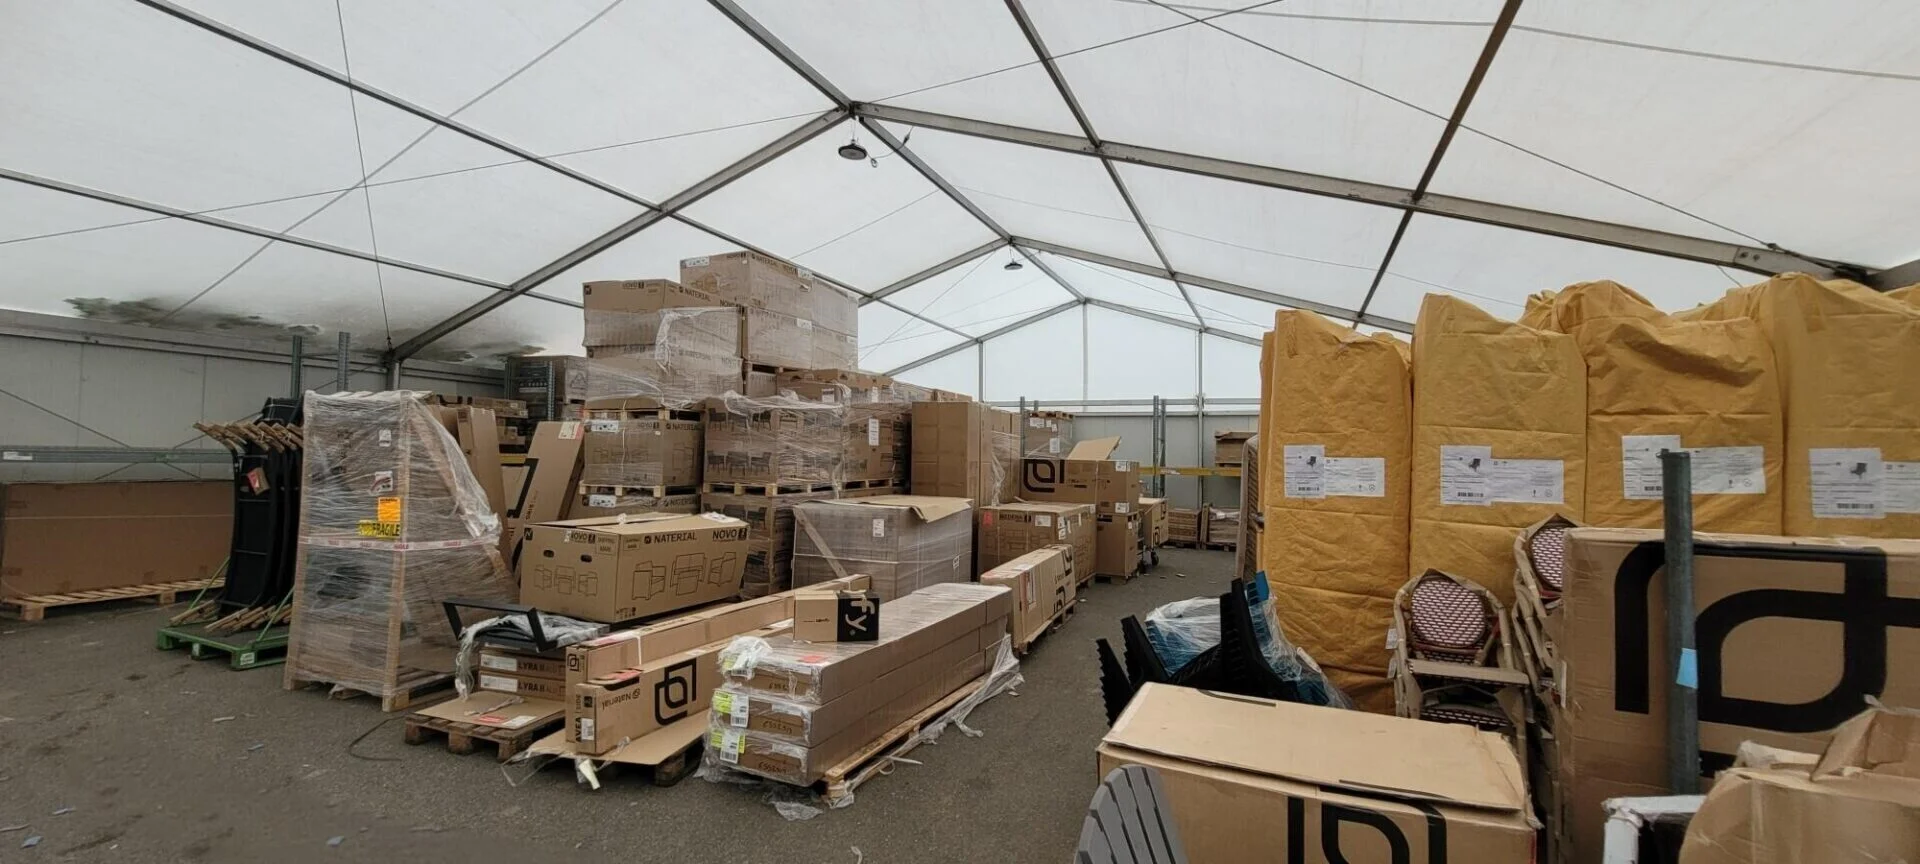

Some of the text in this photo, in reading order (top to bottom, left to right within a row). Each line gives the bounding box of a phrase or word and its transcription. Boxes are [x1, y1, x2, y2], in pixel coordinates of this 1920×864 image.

[684, 288, 711, 301] NATERIAL
[372, 522, 400, 537] FRAGILE
[712, 528, 737, 541] NOVO
[653, 531, 697, 545] NATERIAL
[518, 661, 538, 671] LYRA
[518, 680, 538, 691] LYRA
[601, 692, 631, 711] Naterial
